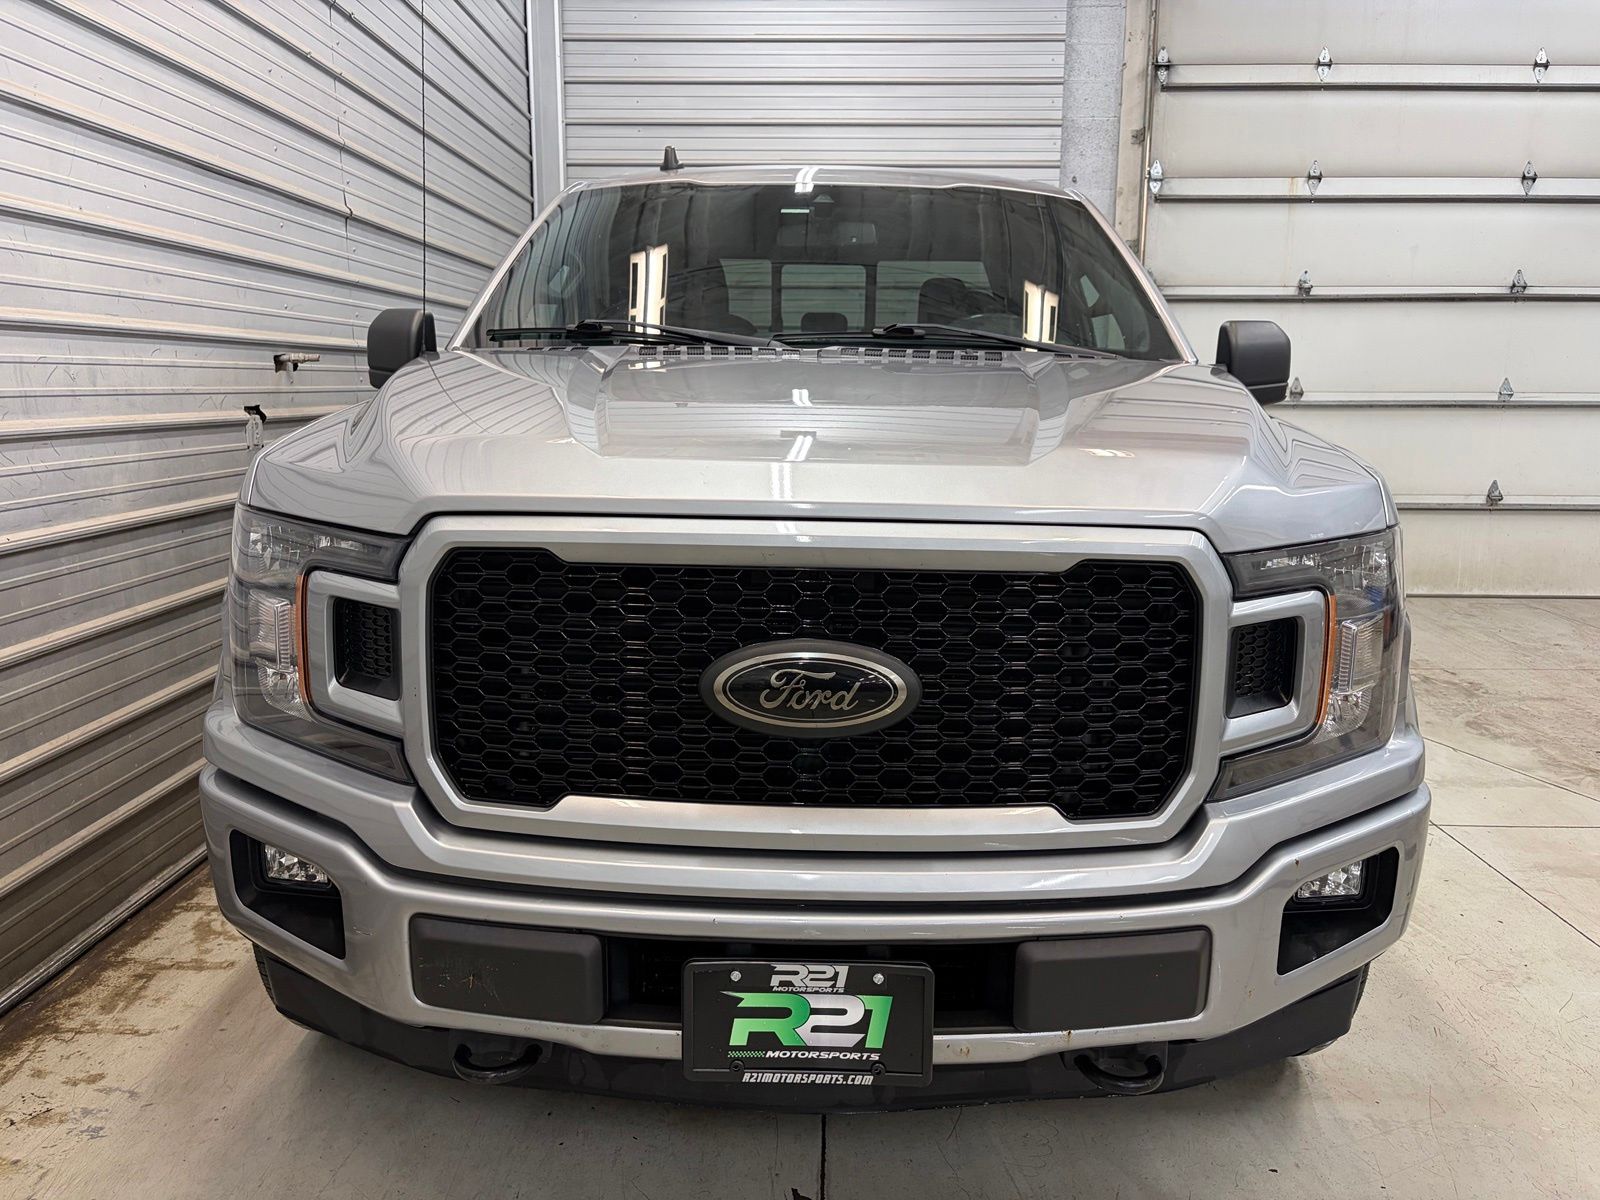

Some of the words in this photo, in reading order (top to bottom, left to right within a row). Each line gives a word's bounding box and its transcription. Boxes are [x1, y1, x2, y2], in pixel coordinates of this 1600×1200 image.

[759, 668, 861, 711] Ford
[770, 965, 849, 987] R21
[720, 991, 893, 1049] R21
[765, 1051, 881, 1061] MOTORSPORTS
[742, 1072, 874, 1086] R21MOTORSPORTS.COM
